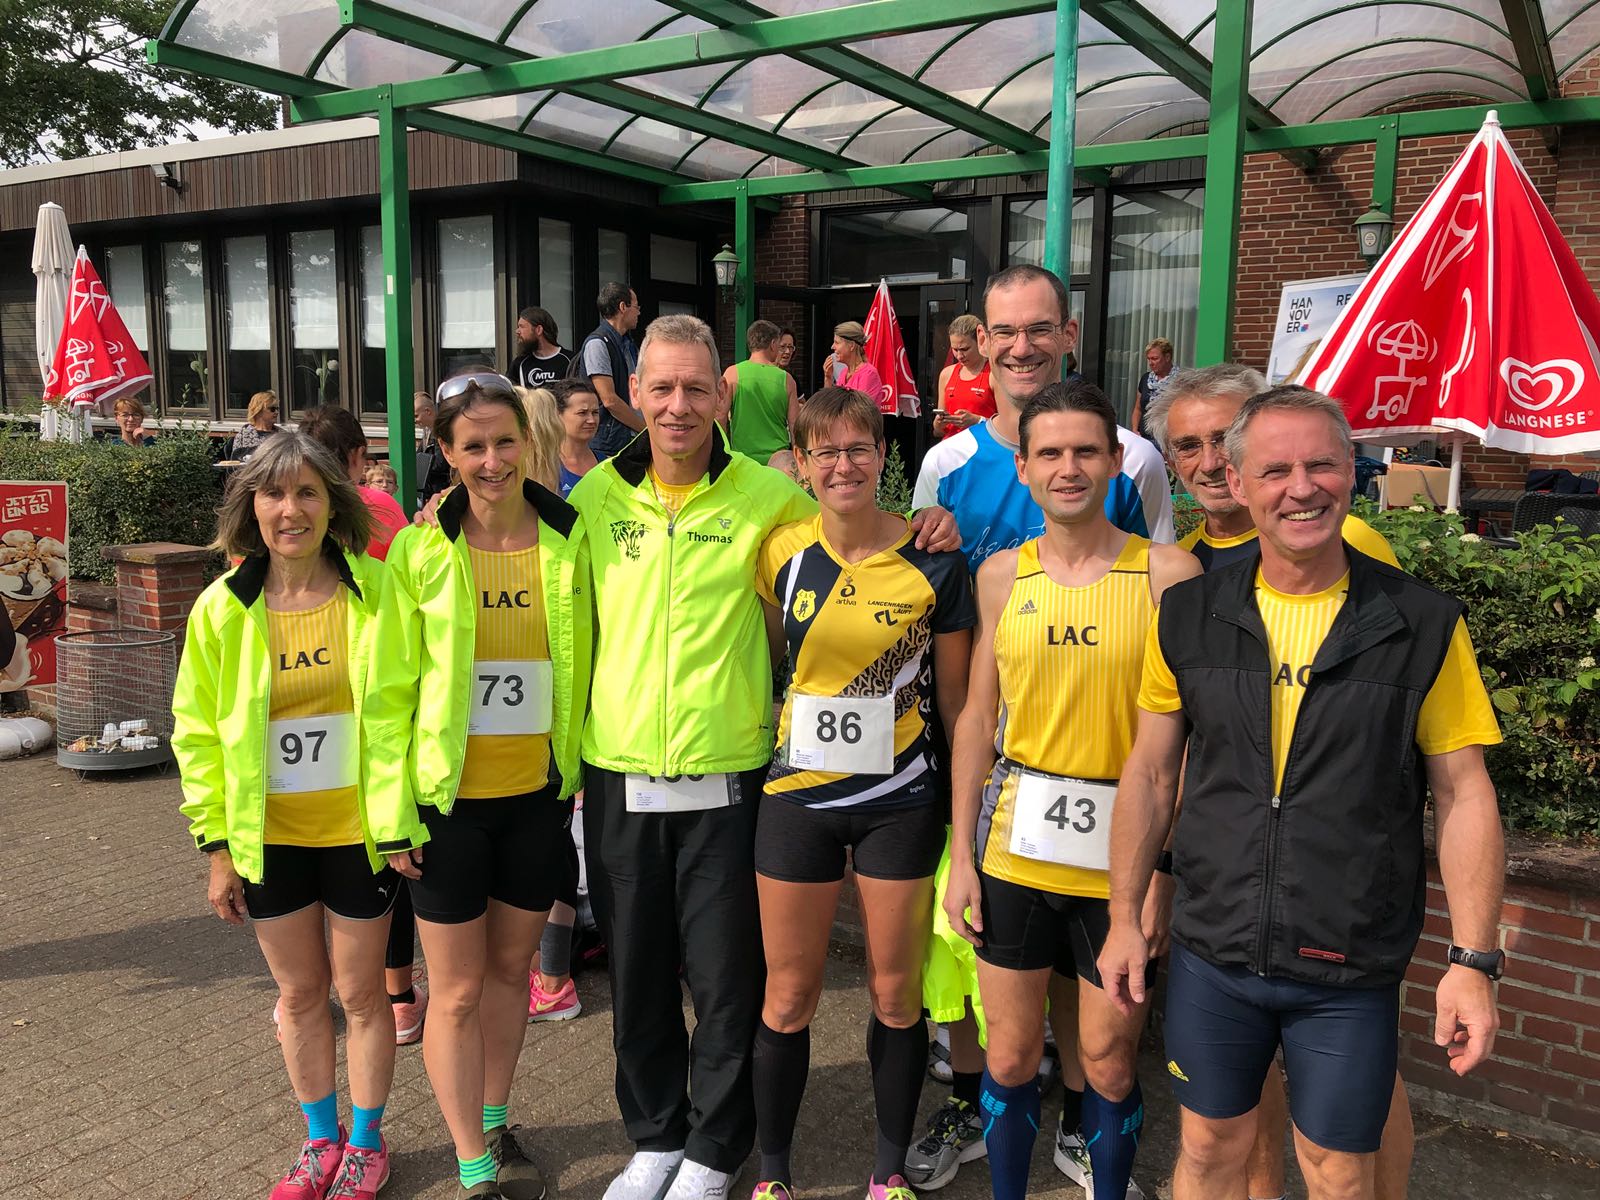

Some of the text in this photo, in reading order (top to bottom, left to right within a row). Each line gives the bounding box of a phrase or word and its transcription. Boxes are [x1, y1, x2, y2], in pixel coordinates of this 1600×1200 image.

[1286, 322, 1300, 333] ER
[1504, 410, 1586, 428] LANGNESE
[6, 493, 47, 507] JETZT
[7, 503, 49, 518] EIN EIS
[687, 531, 733, 544] Thomas
[483, 590, 530, 608] LAC
[836, 598, 857, 606] artiva
[867, 600, 914, 609] LANGENHAGEN
[1017, 608, 1038, 616] adidas
[1047, 625, 1099, 646] LAC
[279, 647, 331, 671] LAC
[478, 674, 525, 707] 73
[816, 710, 862, 744] 86
[280, 730, 327, 765] 97
[1044, 794, 1097, 834] 43
